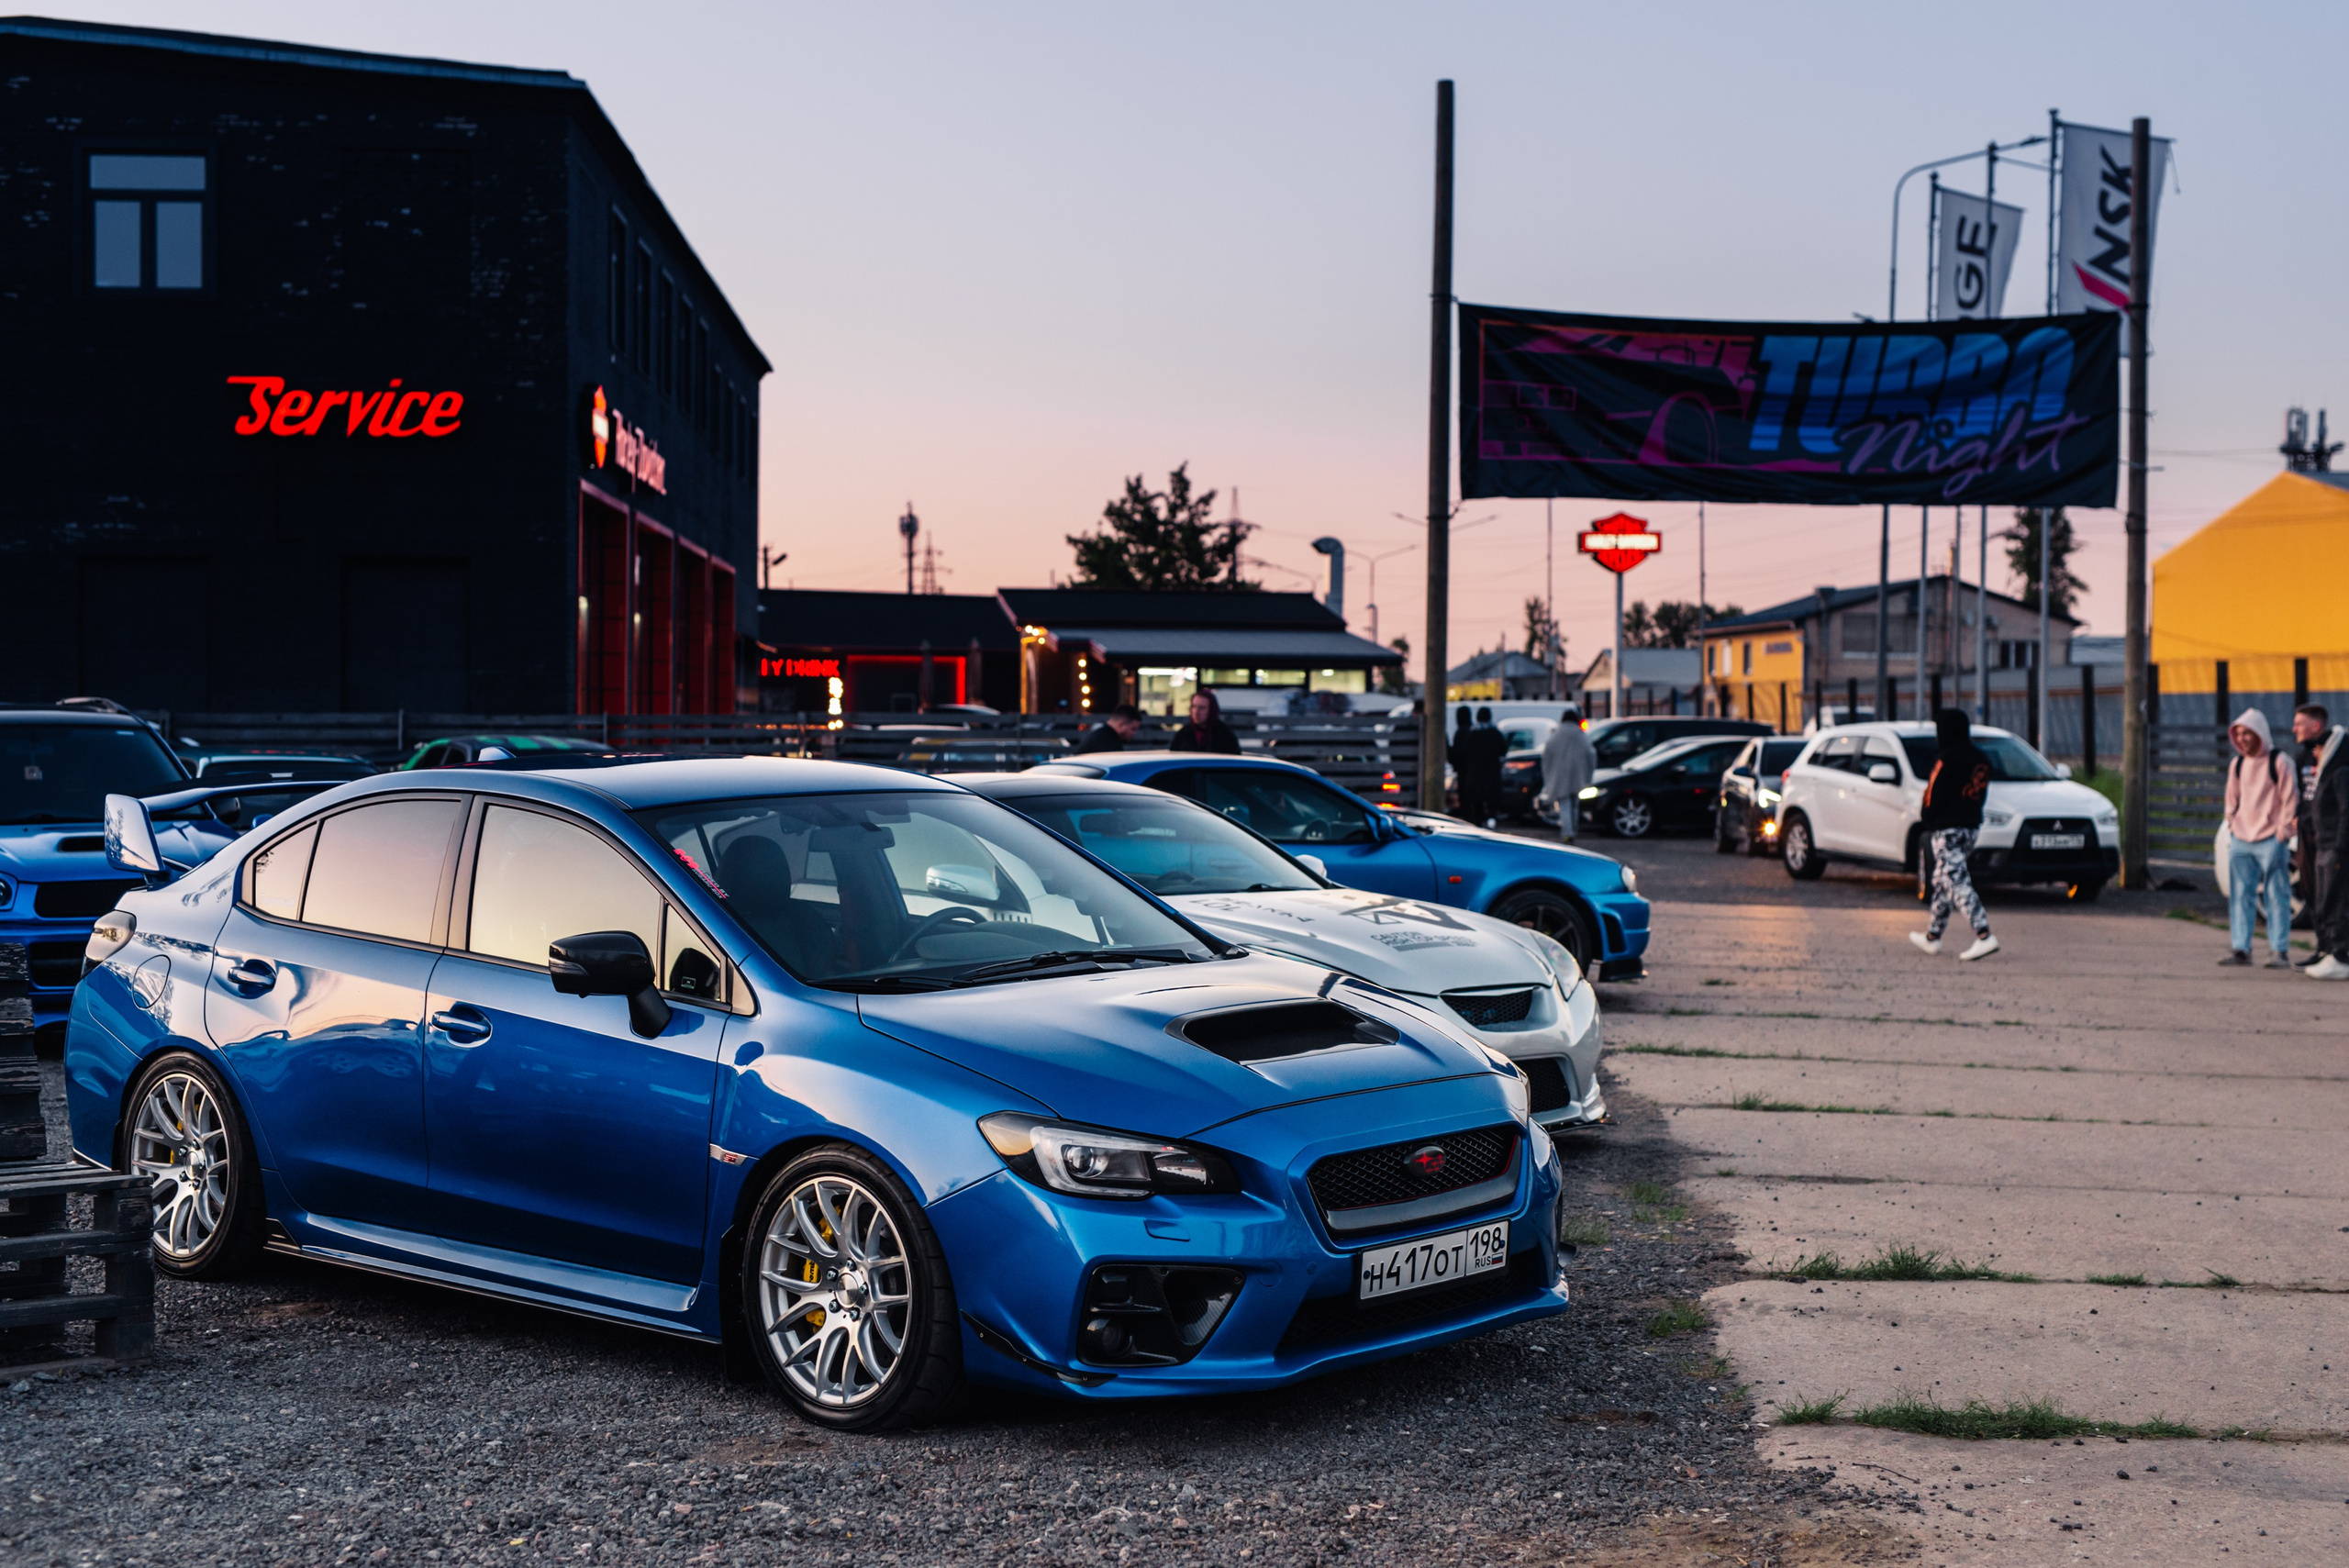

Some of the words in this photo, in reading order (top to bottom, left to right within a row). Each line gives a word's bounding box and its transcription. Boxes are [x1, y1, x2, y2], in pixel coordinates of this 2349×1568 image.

[1954, 215, 1998, 320] GE
[227, 375, 464, 438] Service
[1749, 327, 2076, 454] TURBO
[1840, 406, 2091, 499] Night
[1469, 1226, 1502, 1259] 198
[1475, 1257, 1491, 1269] RUS
